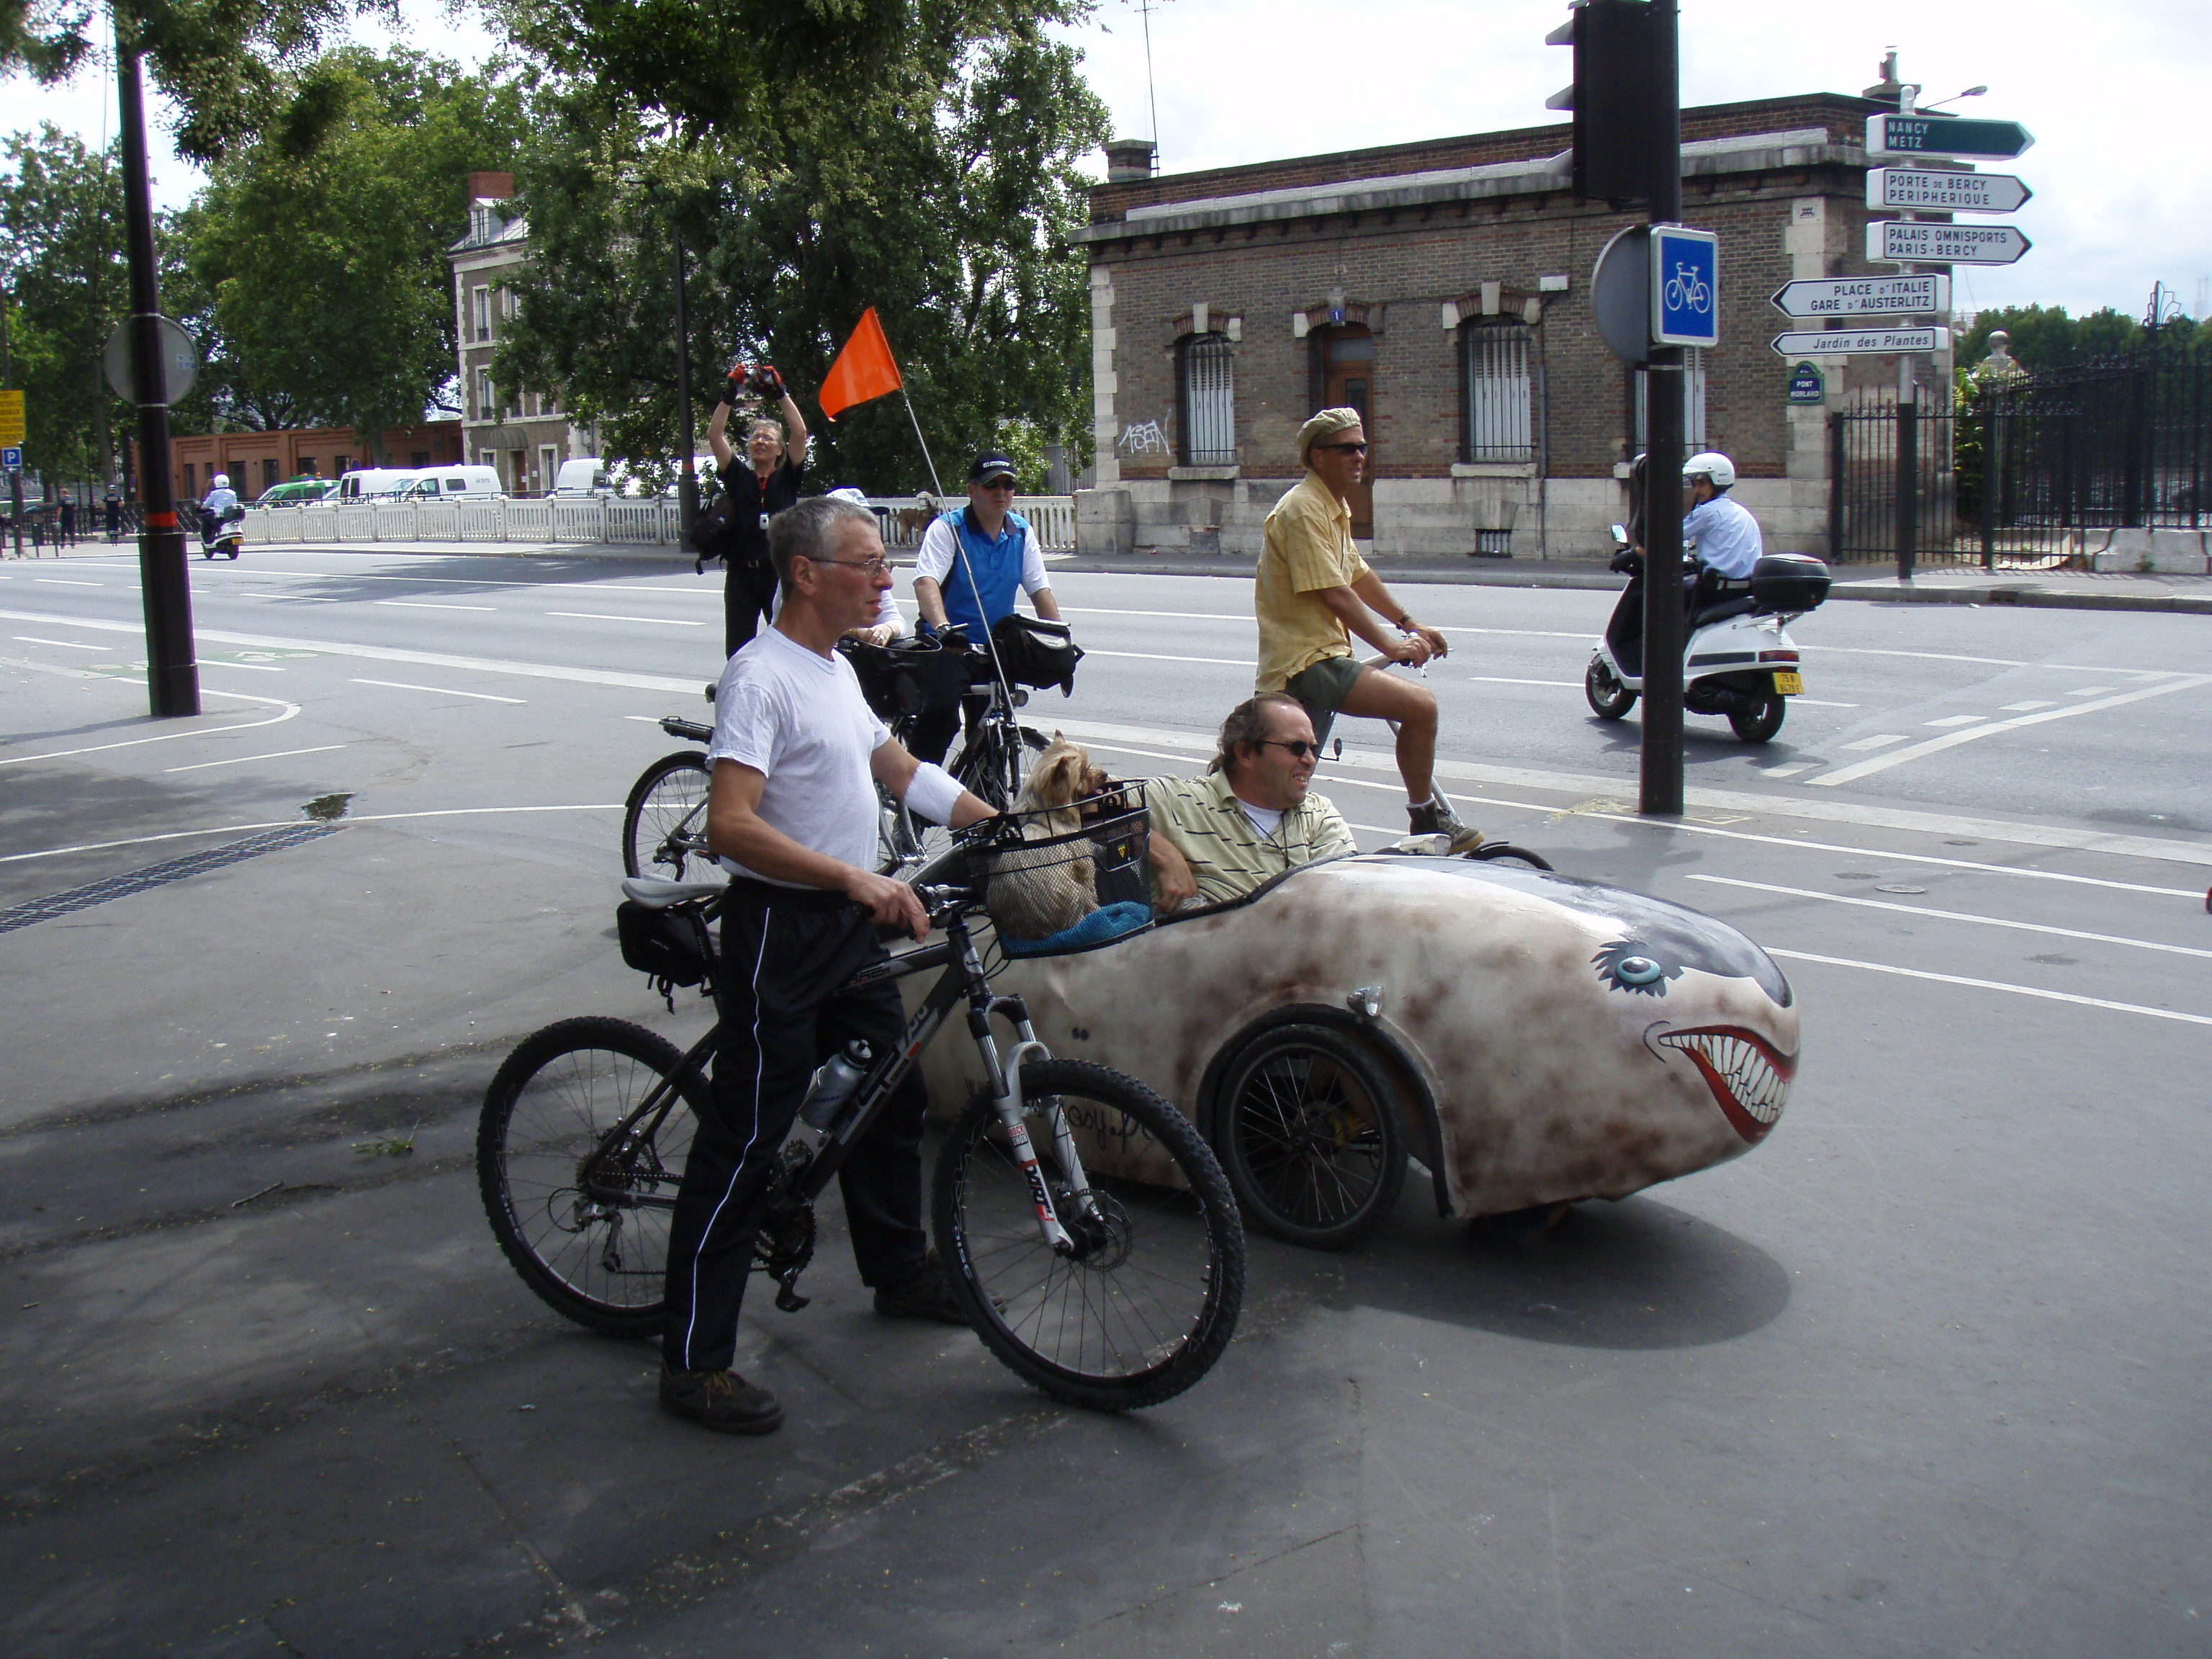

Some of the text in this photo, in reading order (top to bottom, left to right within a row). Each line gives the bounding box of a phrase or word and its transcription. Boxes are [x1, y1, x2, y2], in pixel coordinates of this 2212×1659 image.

[1888, 121, 1929, 135] NANCY
[1888, 135, 1923, 148] METZ
[1889, 175, 1928, 187] PORTE
[1948, 179, 1987, 191] BERCY
[1889, 189, 1990, 205] PERIPHERIQUE
[1889, 228, 2007, 243] PALAIS OMNISPORTS
[1834, 284, 1872, 296] PLACE
[1811, 299, 1840, 311] GARE
[1813, 335, 1929, 349] Jardin des Plantes
[8, 451, 16, 462] P
